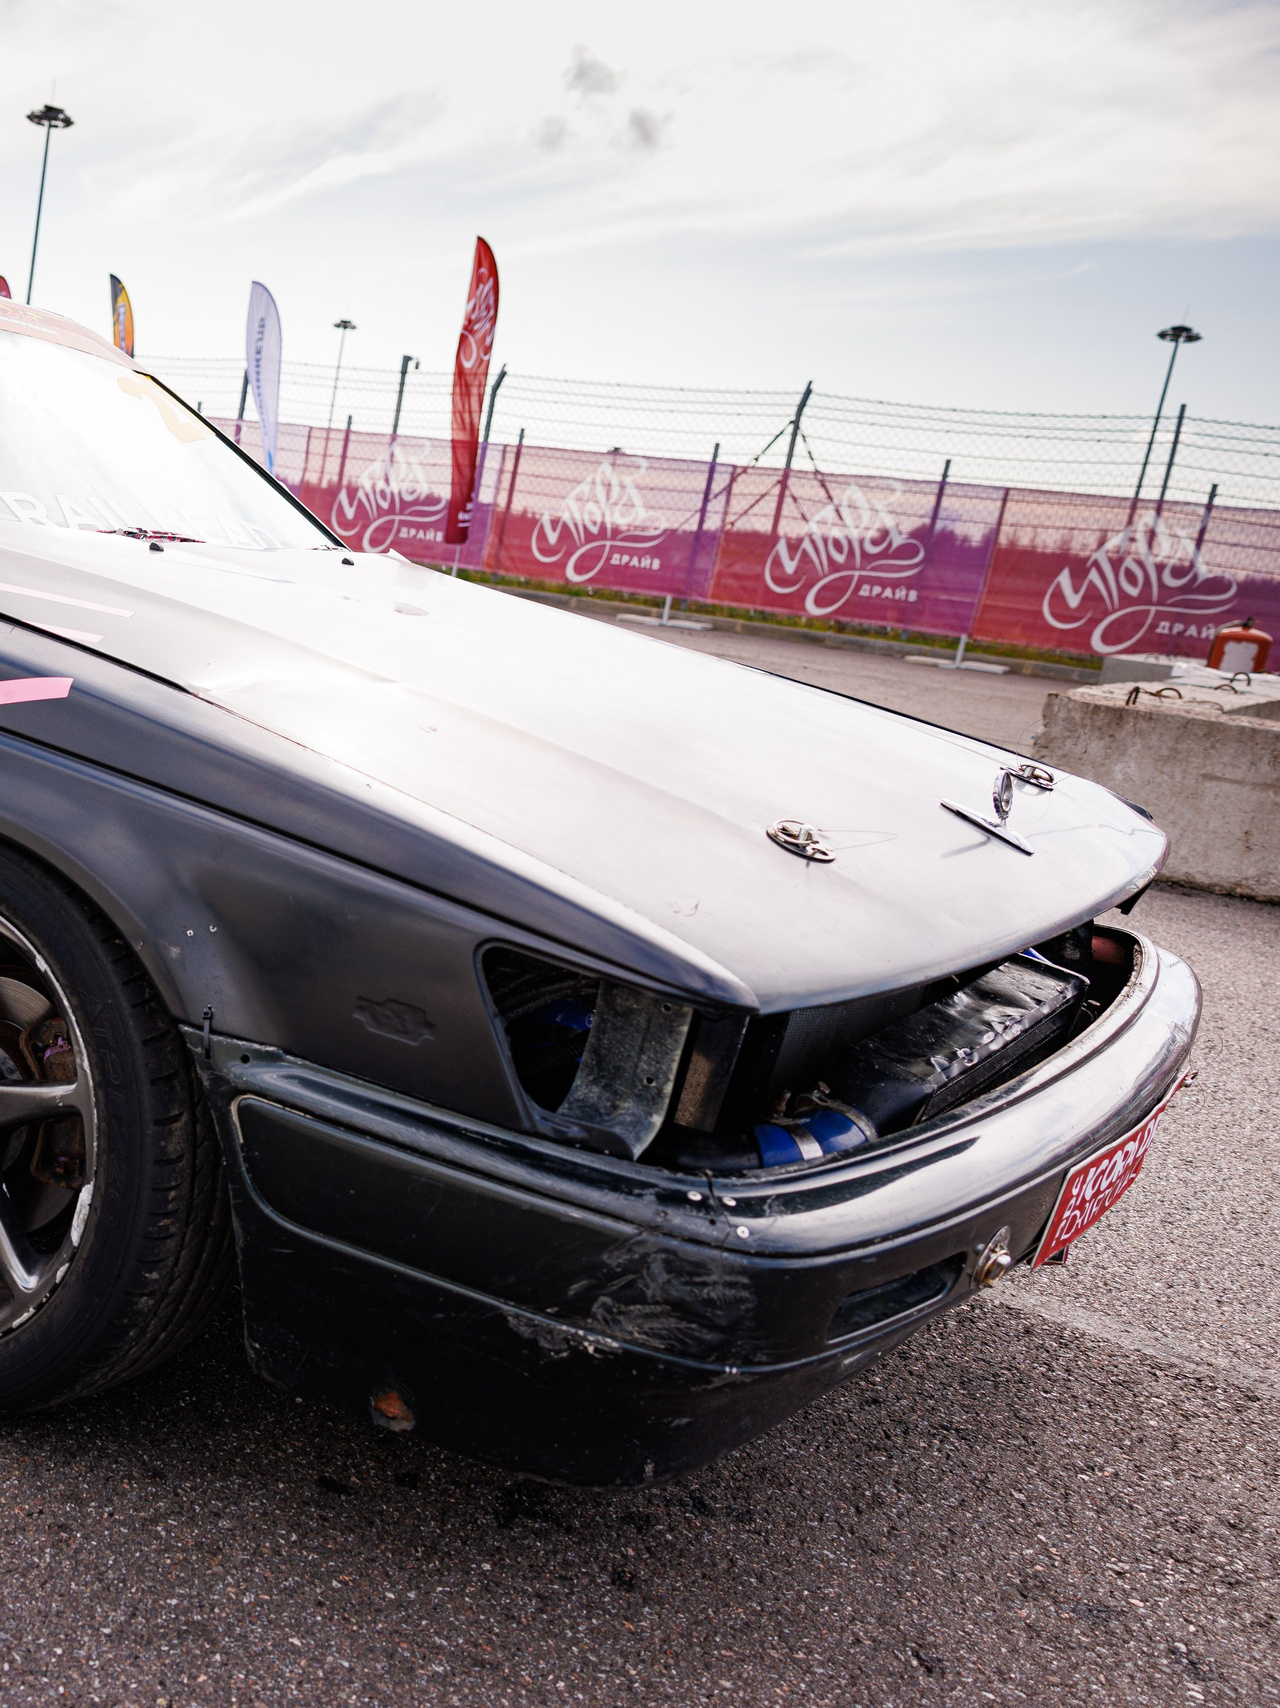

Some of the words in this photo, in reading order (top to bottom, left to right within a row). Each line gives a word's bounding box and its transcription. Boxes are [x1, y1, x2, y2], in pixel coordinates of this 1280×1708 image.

[399, 527, 443, 543] ДРАЙВ
[610, 553, 661, 571] ДРАЙВ
[858, 584, 918, 602] ДРАЙВ
[1155, 620, 1217, 641] ДРАЙ
[1075, 1141, 1139, 1206] IGORA
